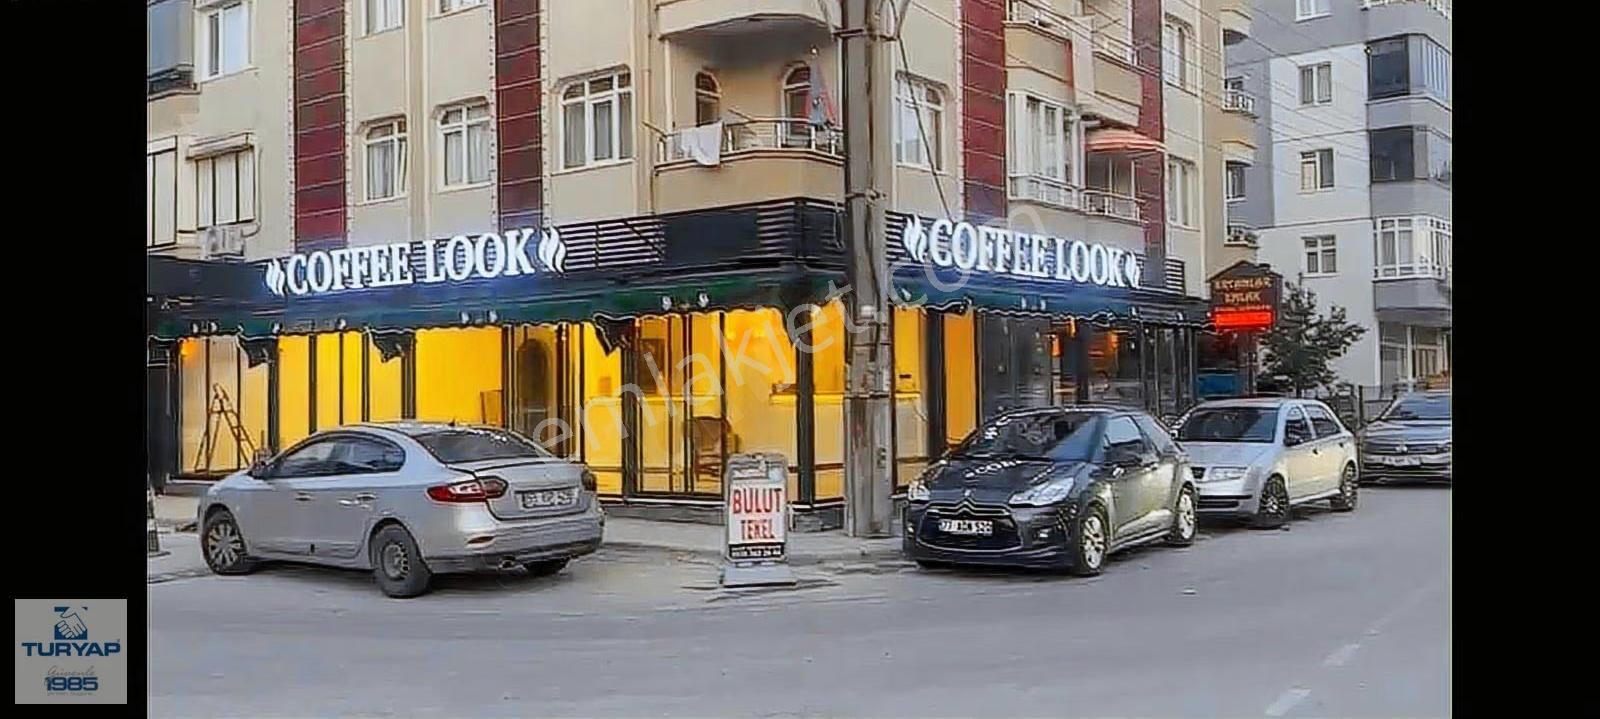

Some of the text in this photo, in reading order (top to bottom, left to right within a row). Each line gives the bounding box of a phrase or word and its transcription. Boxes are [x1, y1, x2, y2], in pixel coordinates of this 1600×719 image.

[287, 227, 535, 296] COFFEE LOOK
[929, 217, 1126, 288] COFFEE LOOK
[732, 487, 783, 514] BULUT
